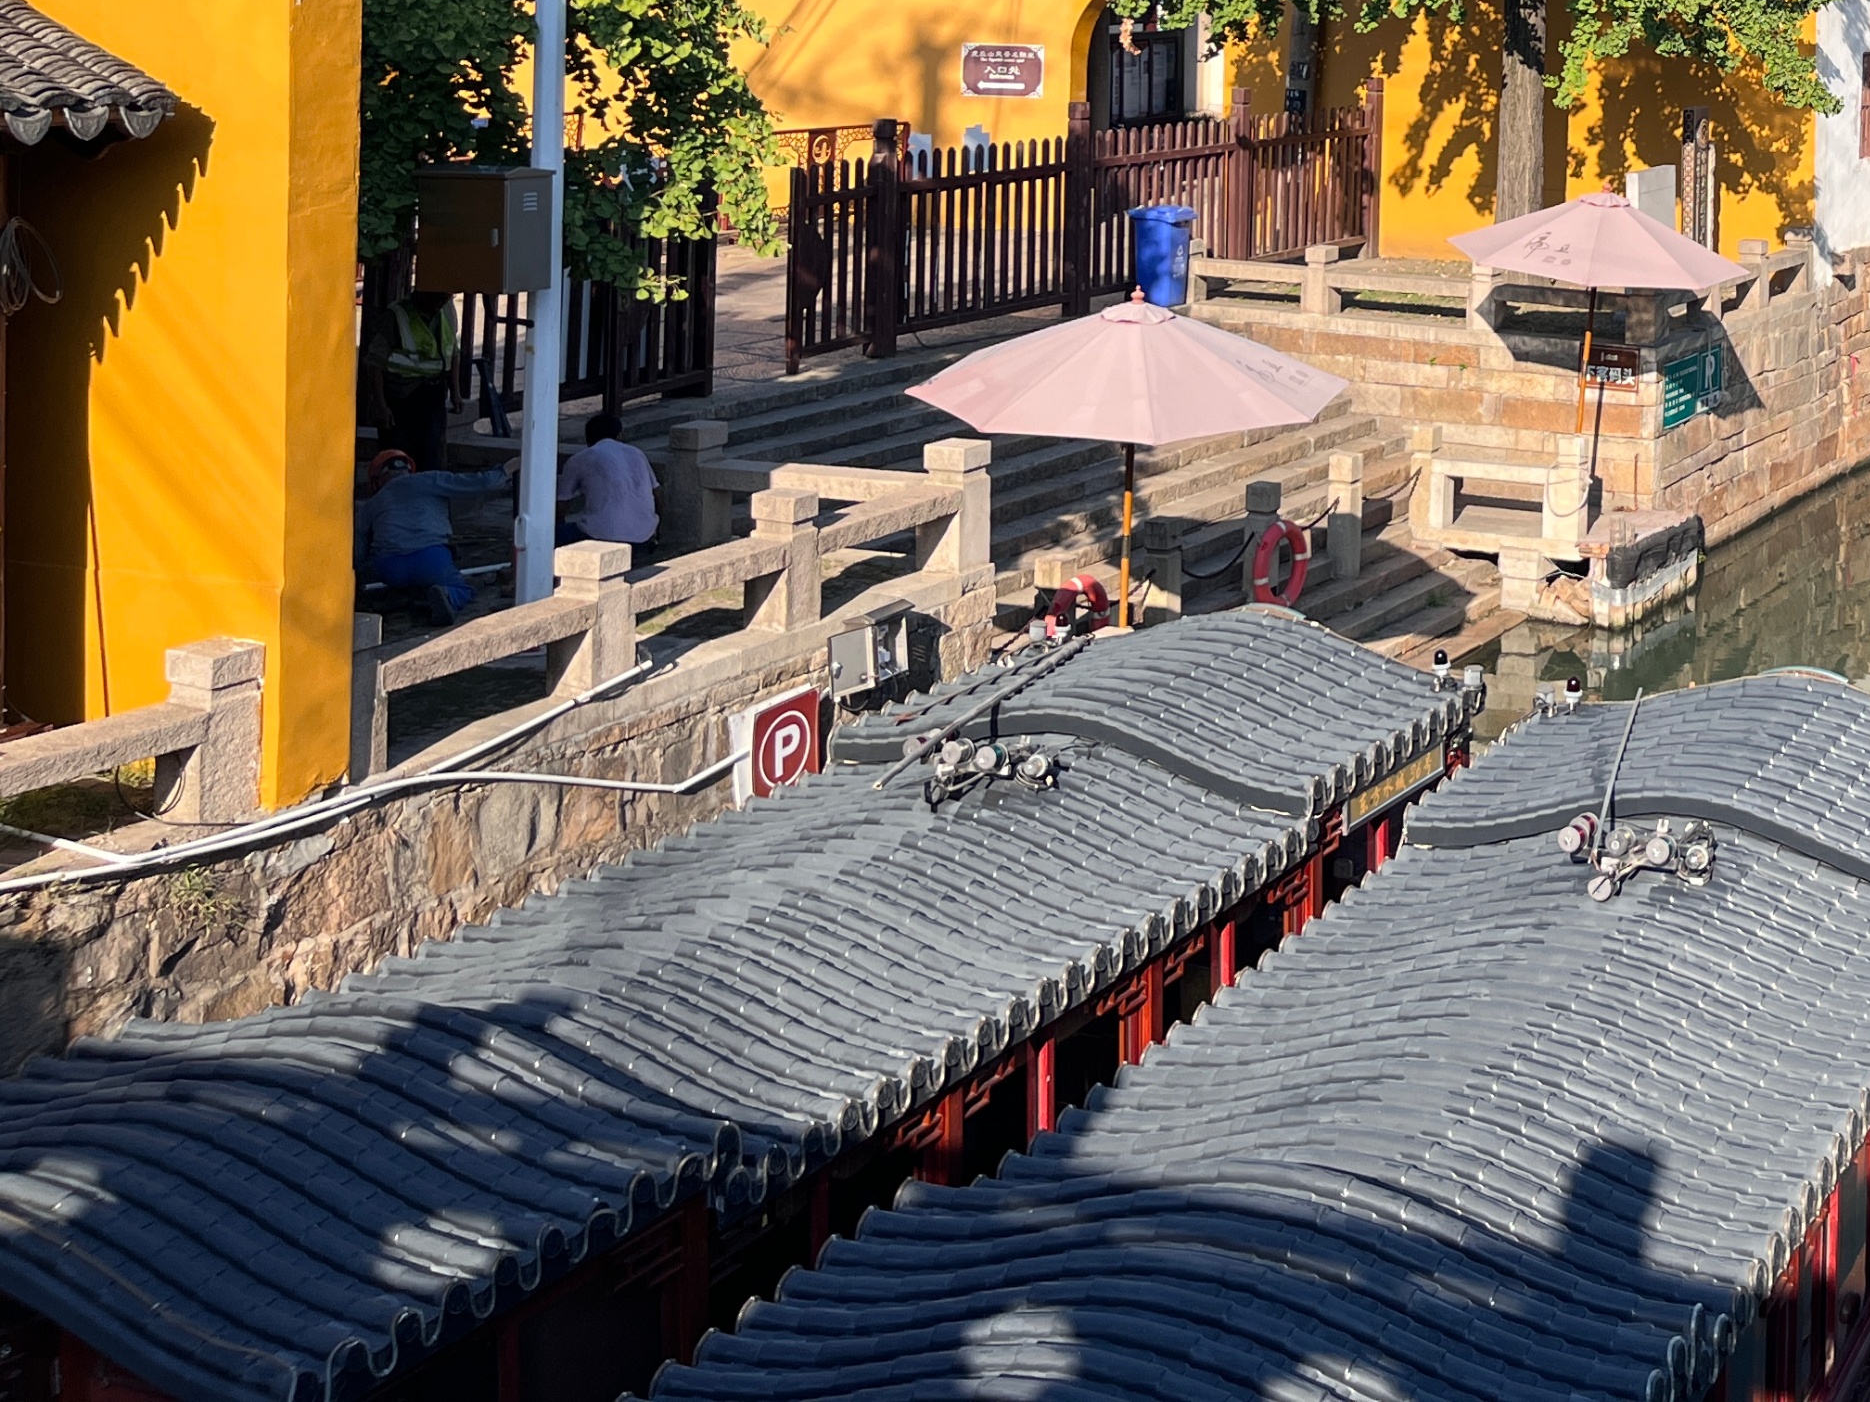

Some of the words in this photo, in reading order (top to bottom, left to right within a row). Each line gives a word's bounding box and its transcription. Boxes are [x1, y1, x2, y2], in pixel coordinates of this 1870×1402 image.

[984, 65, 1021, 75] 入口处
[775, 724, 800, 777] P
